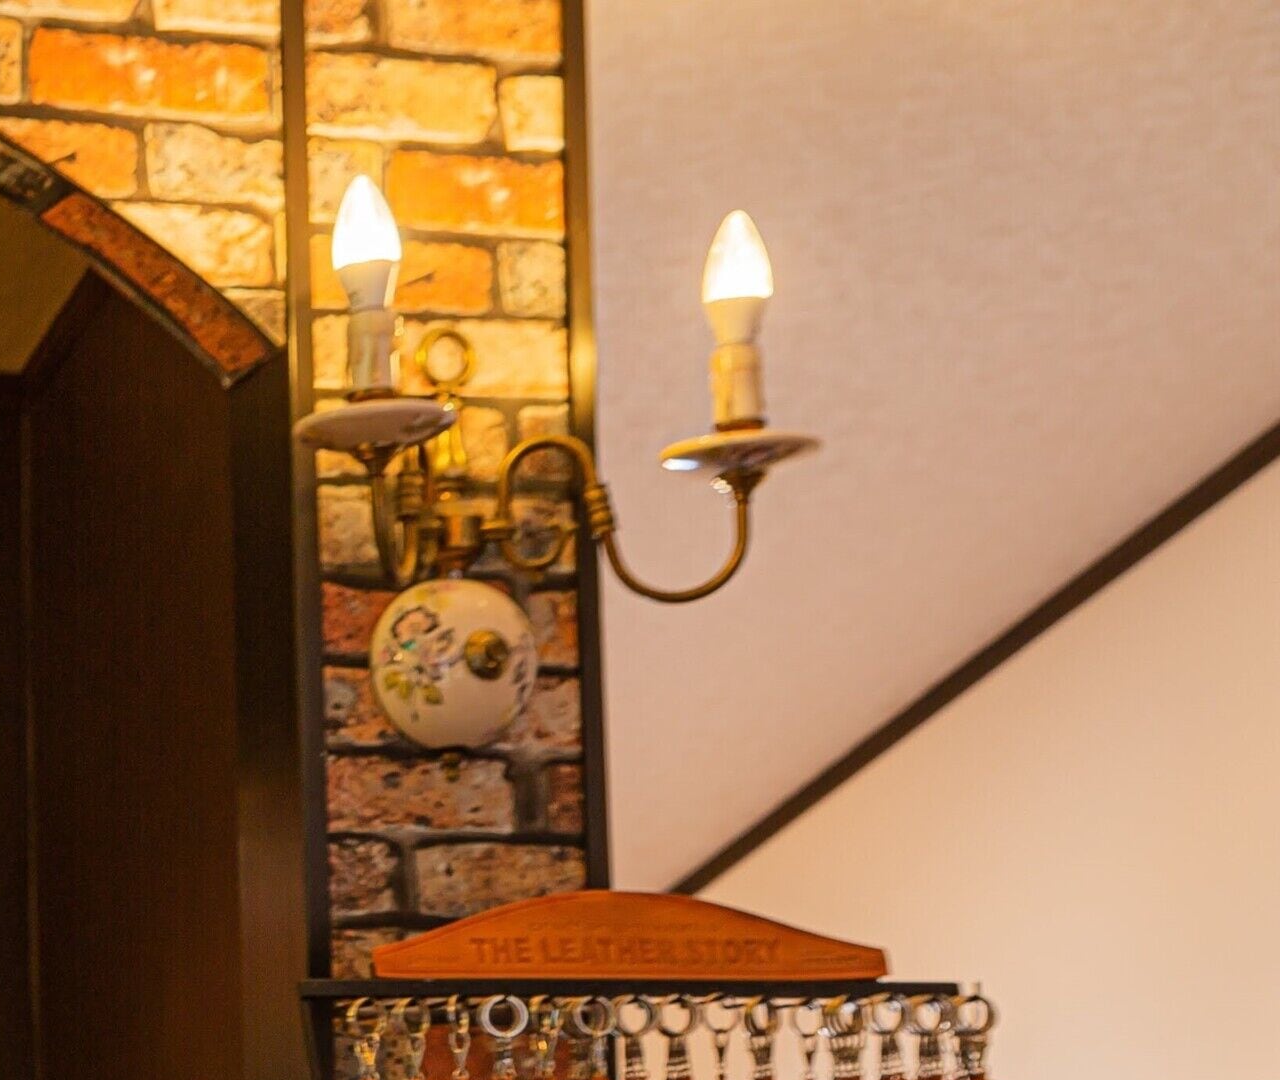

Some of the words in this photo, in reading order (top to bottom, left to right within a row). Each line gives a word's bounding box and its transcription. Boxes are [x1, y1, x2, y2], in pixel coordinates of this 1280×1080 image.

[469, 937, 531, 964] THE
[541, 937, 680, 965] LEATHER
[686, 937, 781, 965] STORY
